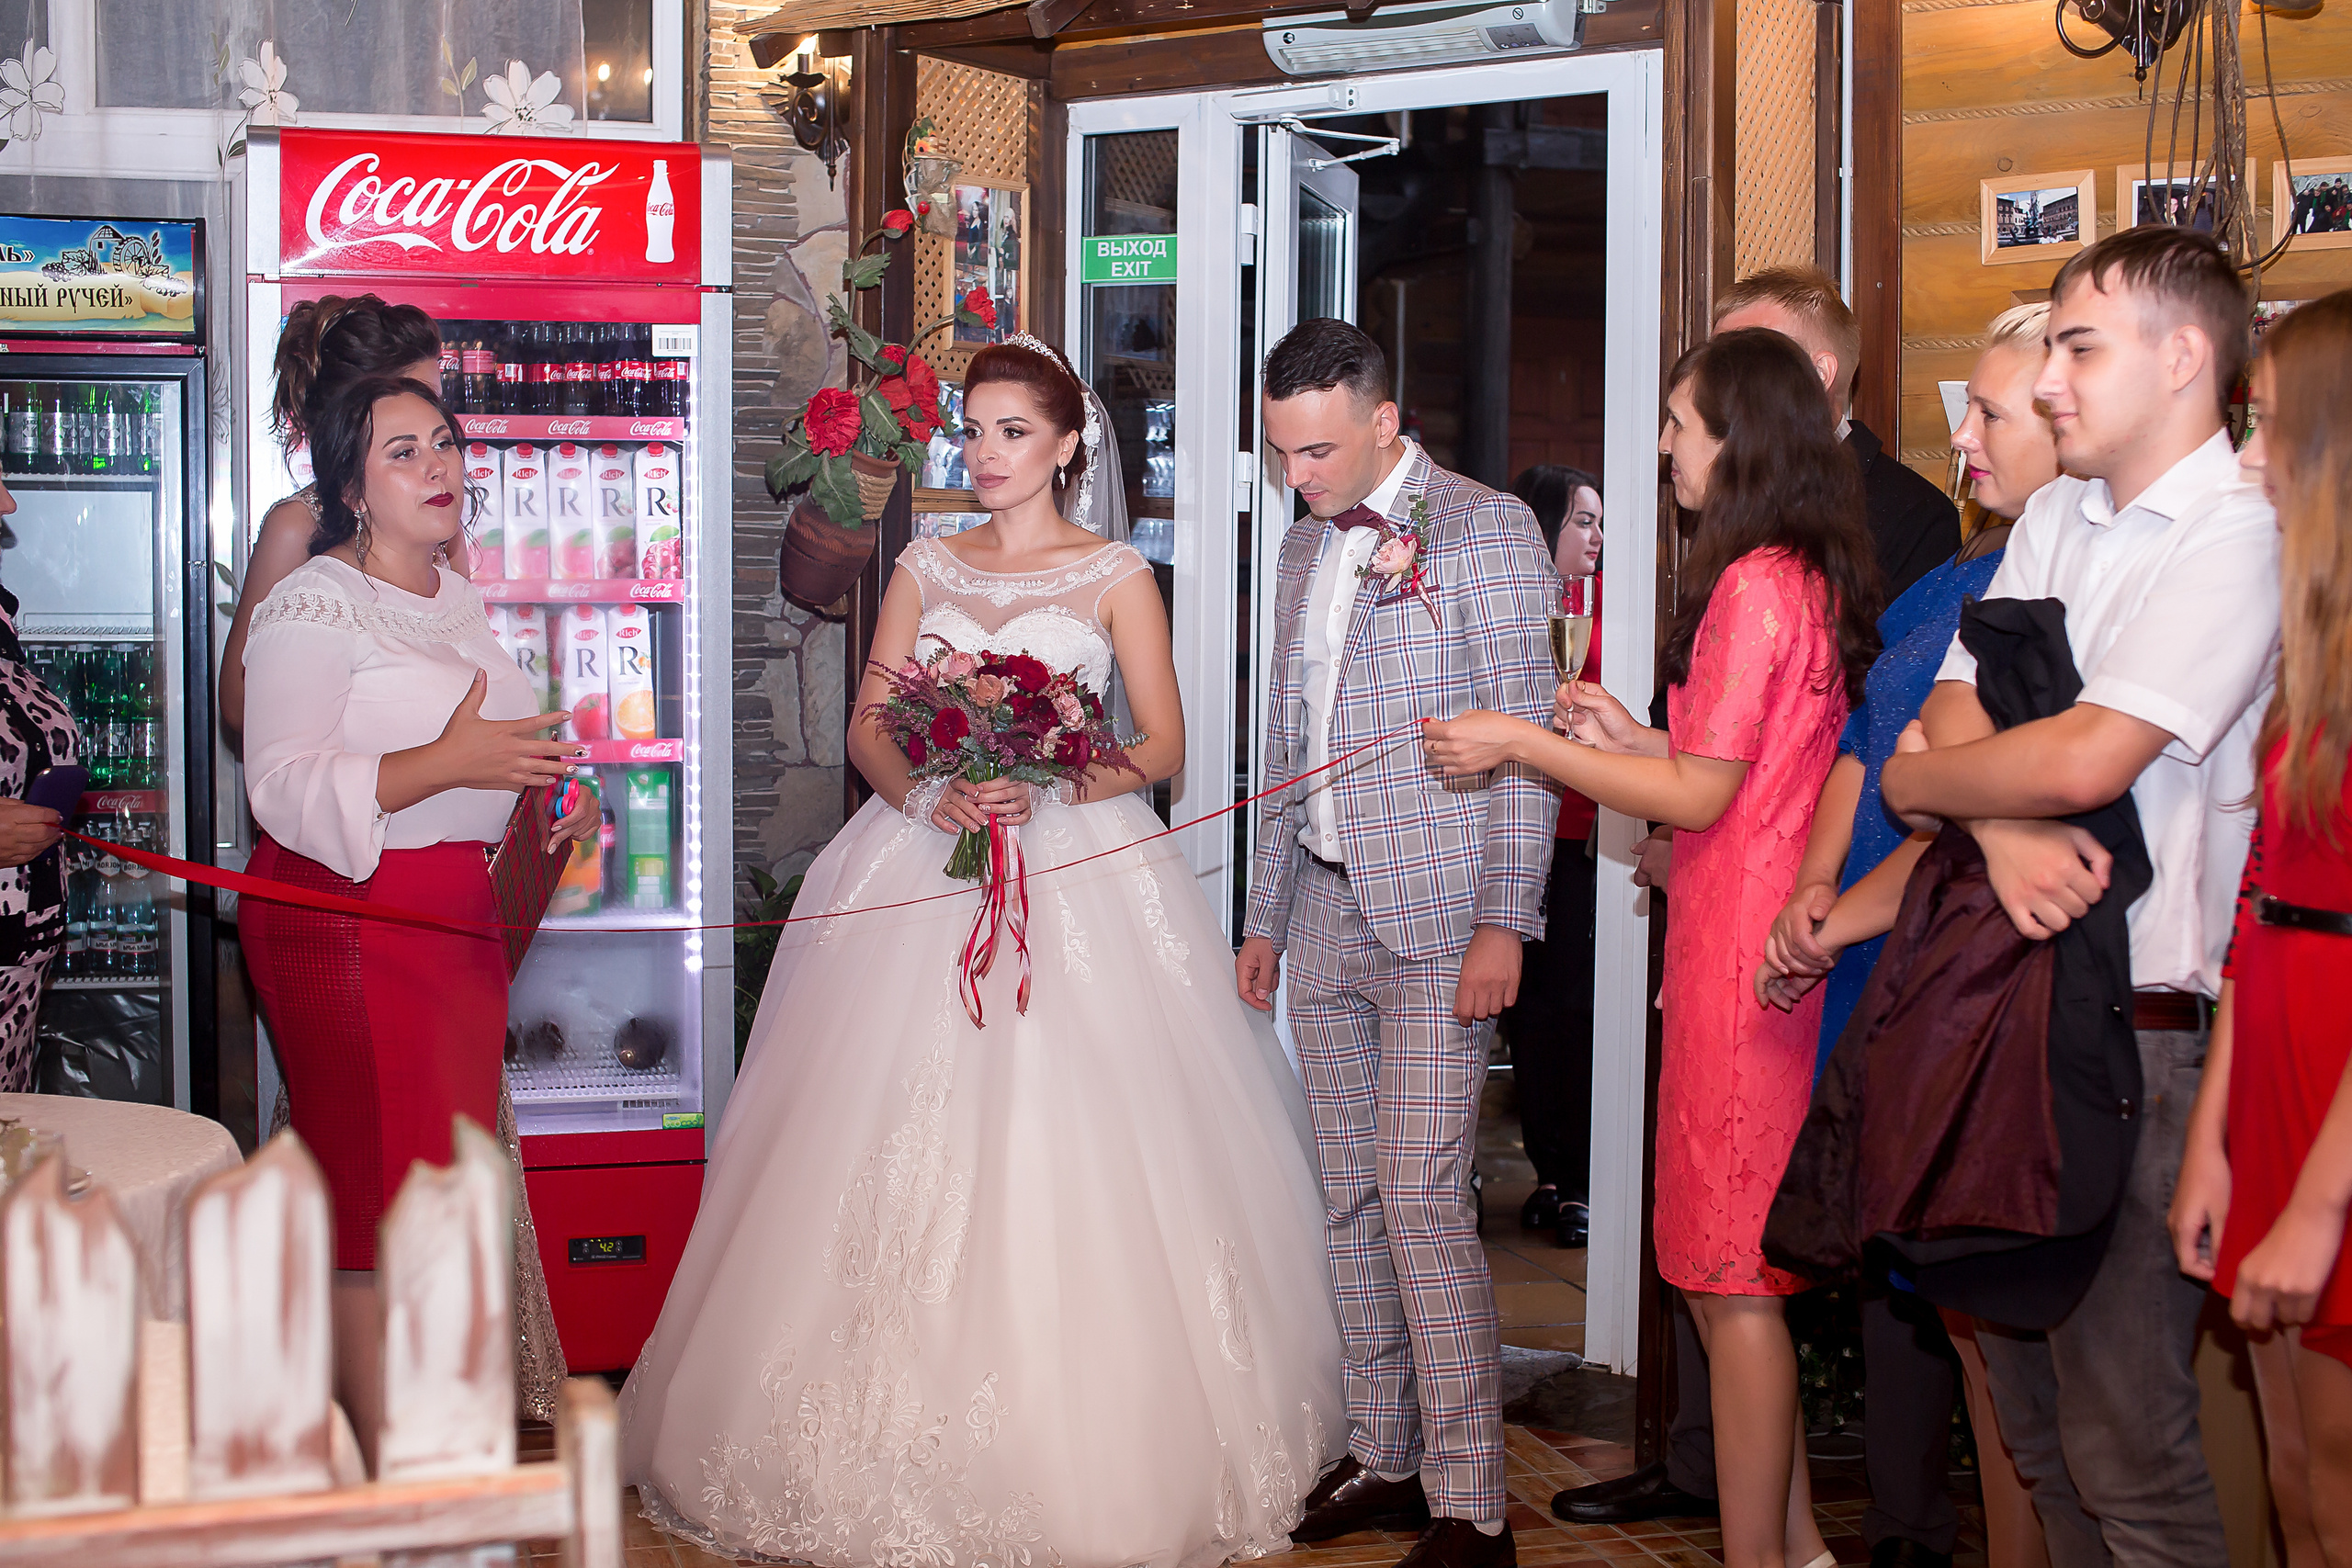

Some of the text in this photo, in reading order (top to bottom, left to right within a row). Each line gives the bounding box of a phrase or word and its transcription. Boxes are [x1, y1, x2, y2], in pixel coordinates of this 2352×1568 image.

[305, 152, 620, 255] Coca-Cola
[1097, 240, 1167, 258] ВЫХОД
[1111, 261, 1152, 277] EXIT
[56, 283, 133, 313] РУЧЕЙ»
[465, 418, 509, 434] Coca-Cola
[548, 420, 592, 436] Coca-Cola
[629, 421, 674, 436] Coca-Cola
[514, 469, 535, 479] Rich
[560, 468, 580, 479] Rich
[602, 470, 623, 480] Rich
[646, 469, 666, 479] Rich
[513, 487, 538, 517] R
[558, 487, 583, 517] R
[601, 487, 628, 517] R
[645, 487, 671, 516] R
[630, 583, 674, 599] Coca-Cola
[618, 628, 639, 637] Rich
[516, 647, 539, 677] R
[575, 648, 600, 678] R
[618, 646, 643, 676] R
[630, 742, 674, 759] Coca-Cola
[96, 794, 143, 810] Coca-Cola
